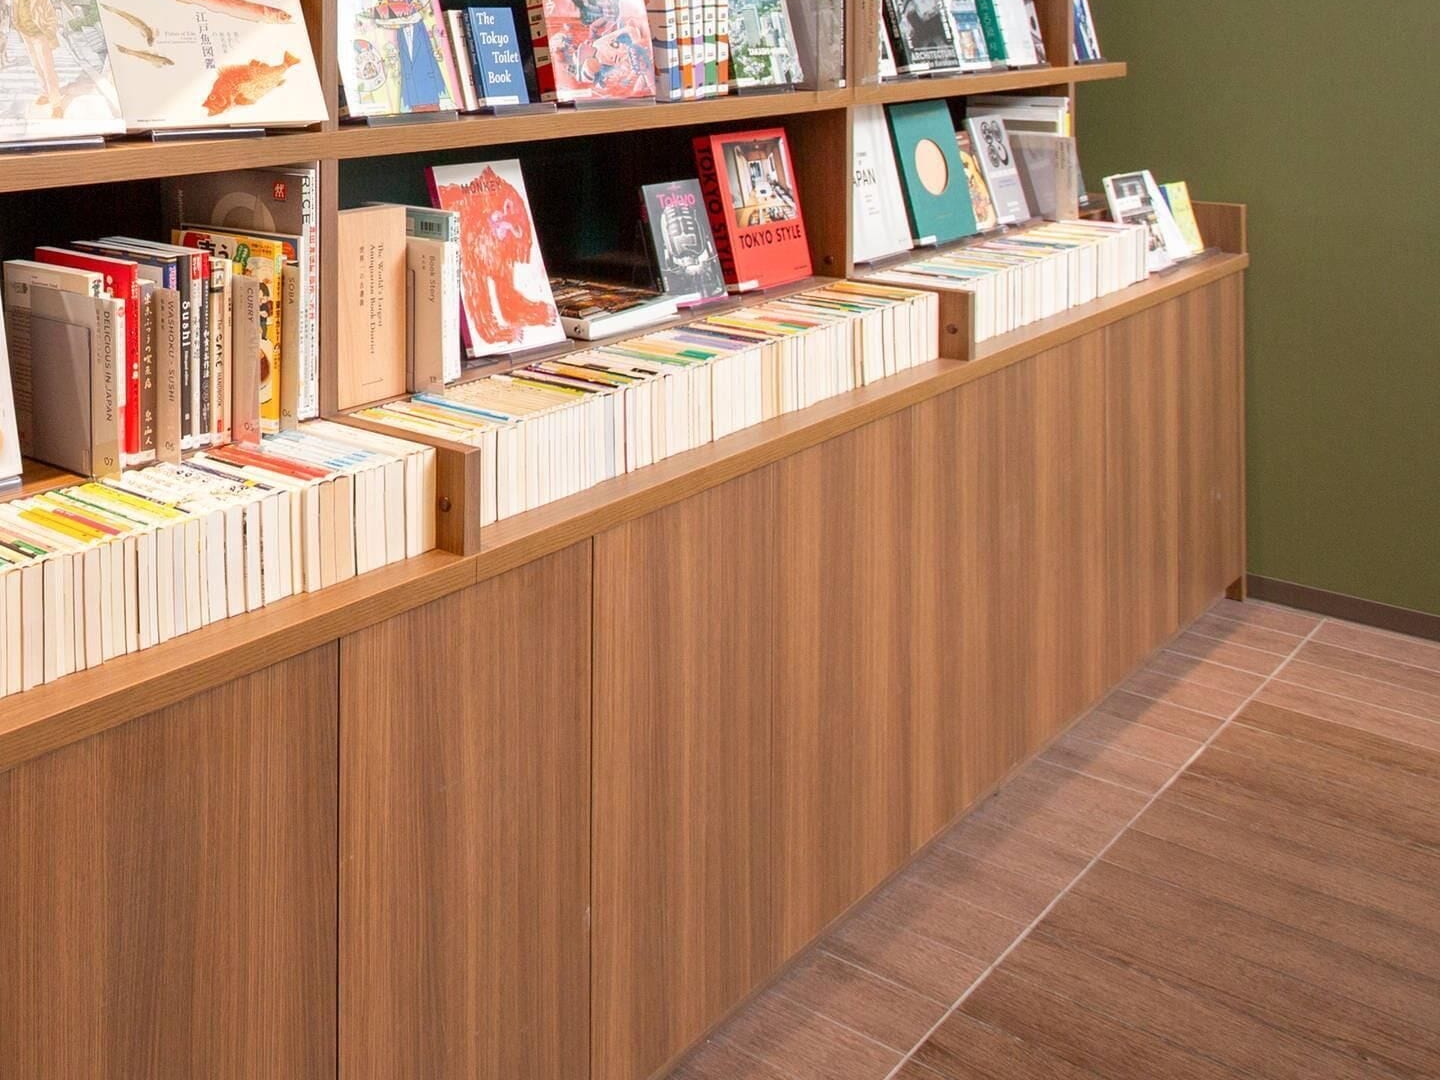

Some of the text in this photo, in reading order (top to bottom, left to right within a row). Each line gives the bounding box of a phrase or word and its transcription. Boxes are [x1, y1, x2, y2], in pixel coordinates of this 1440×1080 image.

[476, 11, 495, 25] The
[480, 32, 509, 51] Tokyo
[492, 52, 519, 64] Toilet
[488, 71, 512, 84] Book
[461, 181, 503, 194] MONKEY
[739, 224, 802, 250] TOKYO STYLE
[247, 288, 255, 322] CURRY
[167, 301, 175, 358] WASHOKU
[102, 311, 111, 371] DELICIOUS
[104, 382, 113, 422] JAPAN
